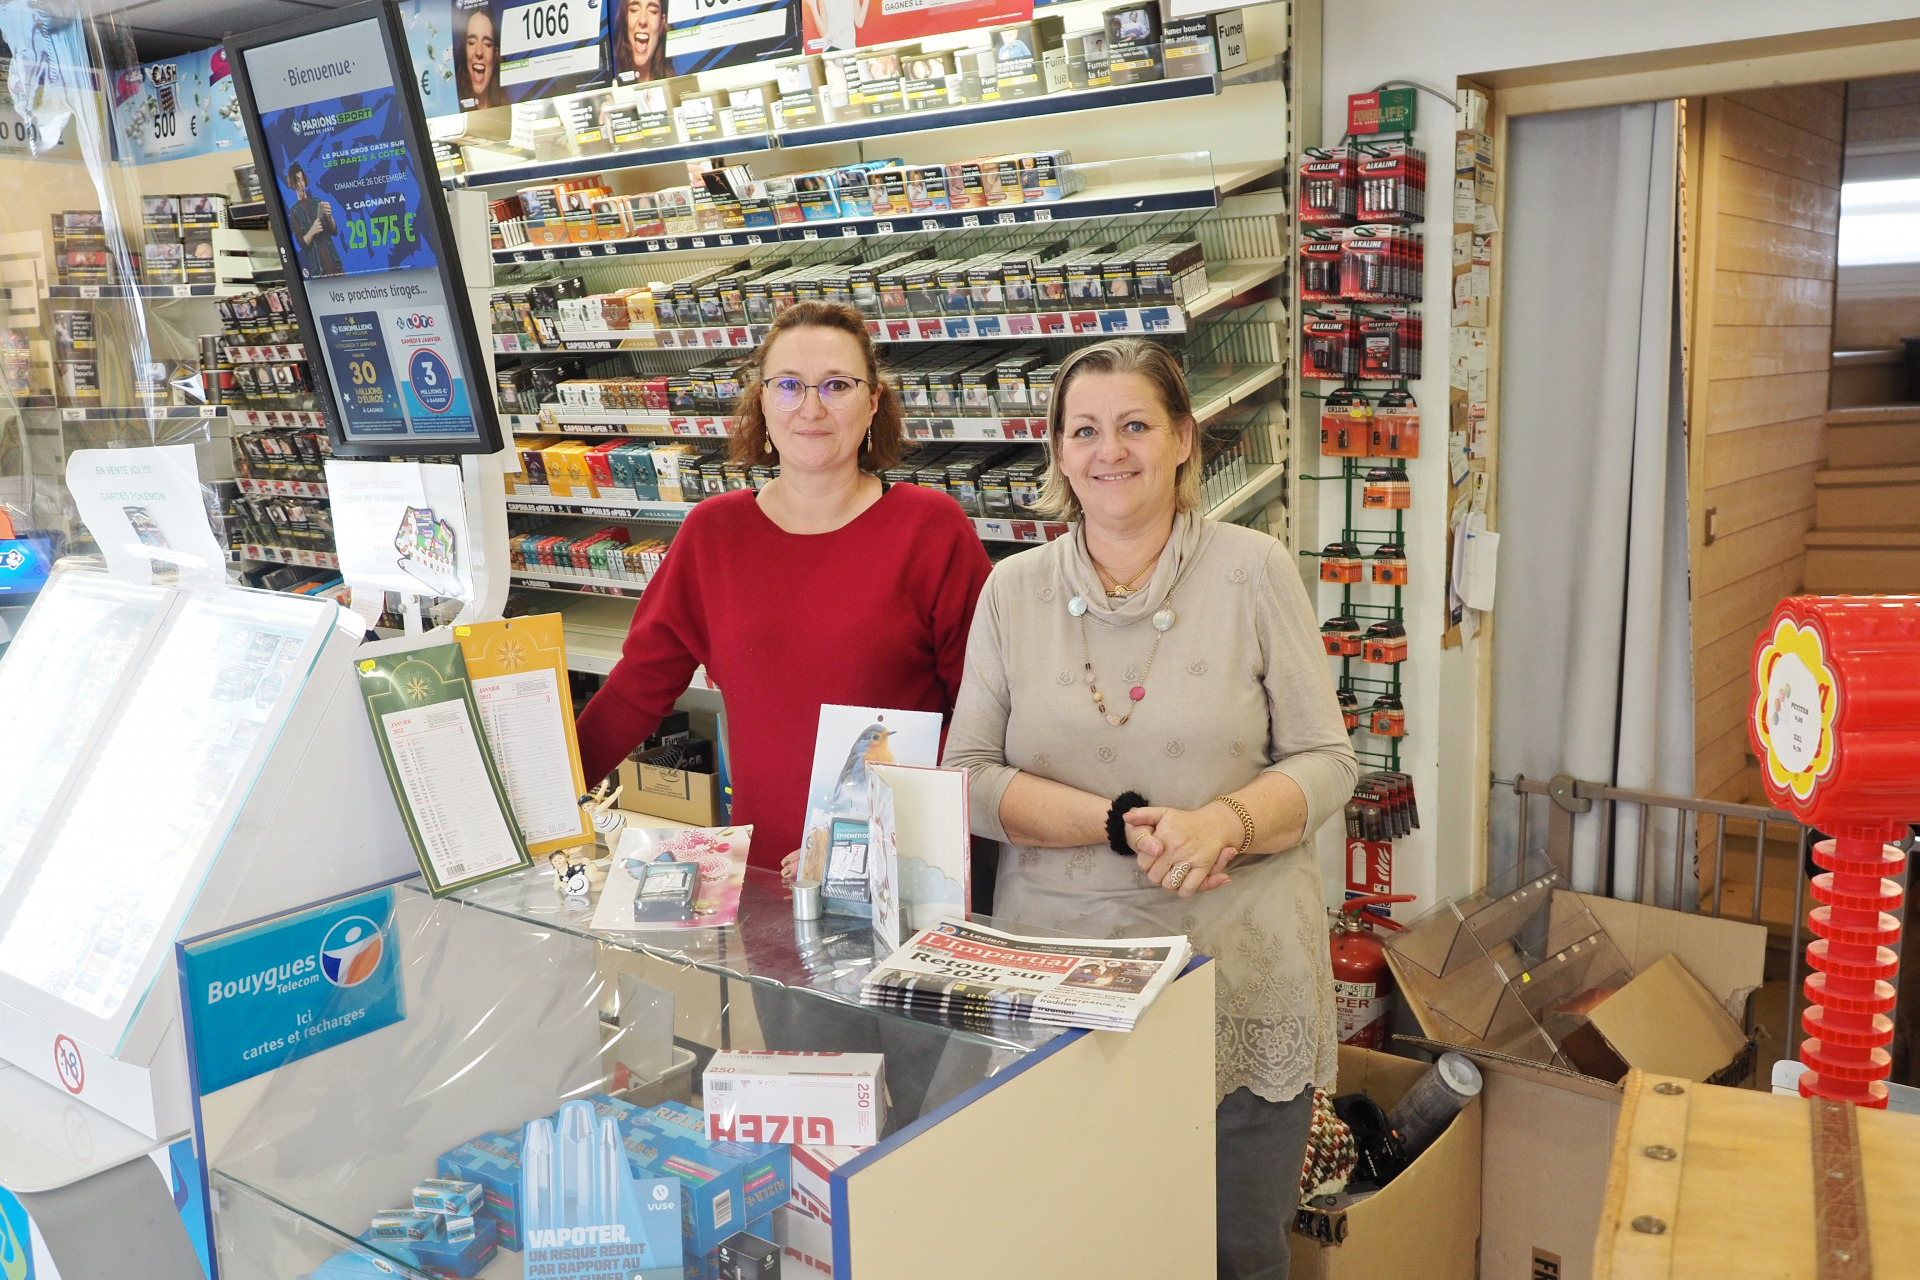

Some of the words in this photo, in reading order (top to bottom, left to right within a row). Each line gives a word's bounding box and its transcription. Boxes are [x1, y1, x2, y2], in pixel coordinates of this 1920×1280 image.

[522, 2, 569, 40] 1066
[1164, 28, 1182, 36] Fumer
[1184, 23, 1206, 32] bouche
[1220, 24, 1243, 38] Fumer
[1176, 34, 1198, 43] artères
[1228, 44, 1240, 56] tue
[288, 59, 352, 86] Bienvenue
[1088, 60, 1108, 70] Fumer
[421, 70, 431, 95] €
[1054, 74, 1066, 85] tue
[1088, 71, 1096, 79] la
[154, 112, 176, 139] 500
[190, 114, 198, 137] €
[302, 114, 337, 130] PARIONS
[337, 108, 372, 123] SPORT
[332, 150, 350, 158] PLUS
[350, 146, 368, 154] GROS
[370, 142, 388, 152] GAIN
[390, 140, 404, 148] SUR
[323, 160, 338, 168] LES
[340, 155, 368, 165] PARIS
[1309, 162, 1339, 170] ALKALINE
[1366, 160, 1398, 170] ALKALINE
[334, 179, 366, 191] DIMANCHE
[375, 172, 408, 184] DÉCEMBRE
[354, 196, 396, 209] GAGNANT
[346, 220, 368, 249] 29
[370, 214, 400, 246] 575
[329, 290, 344, 302] Vos
[348, 287, 388, 304] prochains
[406, 312, 434, 330] LOTO
[350, 361, 376, 384] 30
[421, 362, 436, 386] 3
[355, 387, 382, 396] MILLIONS
[96, 466, 105, 476] EN
[106, 465, 129, 476] VENTE
[130, 465, 141, 475] ICI
[100, 492, 128, 502] CARTES
[508, 503, 534, 512] CAPSULES
[582, 507, 610, 516] CAPSULES
[479, 686, 500, 694] JANVIER
[391, 719, 412, 728] JANVIER
[924, 934, 1073, 968] L'Impartial
[910, 951, 1002, 973] Retour
[1007, 970, 1051, 980] sur
[208, 954, 316, 1004] Bouygues
[936, 968, 1002, 982] 2021
[277, 974, 320, 995] Telecom
[1040, 998, 1077, 1007] tradition
[1336, 997, 1369, 1008] PER
[296, 1010, 312, 1026] Ici
[242, 1036, 285, 1060] cartes
[288, 1028, 300, 1044] et
[304, 1008, 366, 1038] recharges
[858, 1084, 870, 1108] 250
[710, 1114, 834, 1145] GIZEH
[647, 1202, 674, 1210] vuse
[528, 1224, 631, 1249] VAPOTER,
[528, 1250, 548, 1262] UN
[551, 1246, 597, 1260] RISQUE
[600, 1242, 646, 1256] RÉDUIT
[529, 1264, 556, 1276] PAR
[558, 1259, 620, 1274] RAPPORT
[622, 1258, 640, 1269] AU
